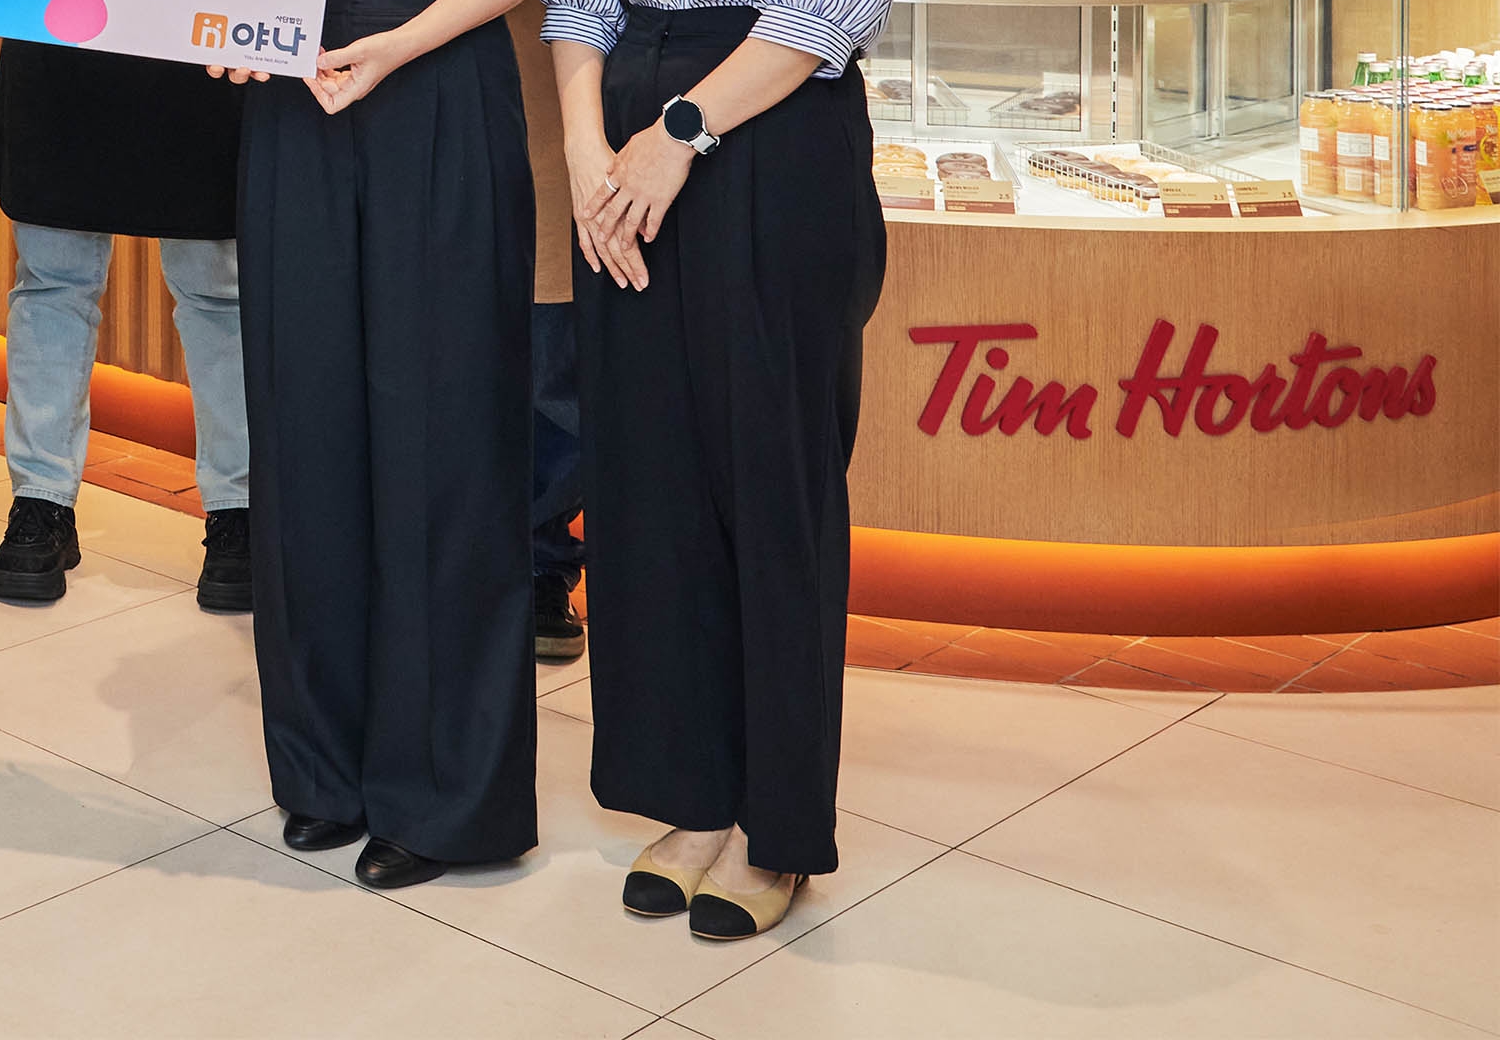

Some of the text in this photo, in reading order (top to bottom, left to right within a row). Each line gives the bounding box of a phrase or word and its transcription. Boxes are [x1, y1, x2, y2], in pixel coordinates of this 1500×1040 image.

[231, 22, 307, 57] 야나
[908, 318, 1437, 440] Tim Hortons
